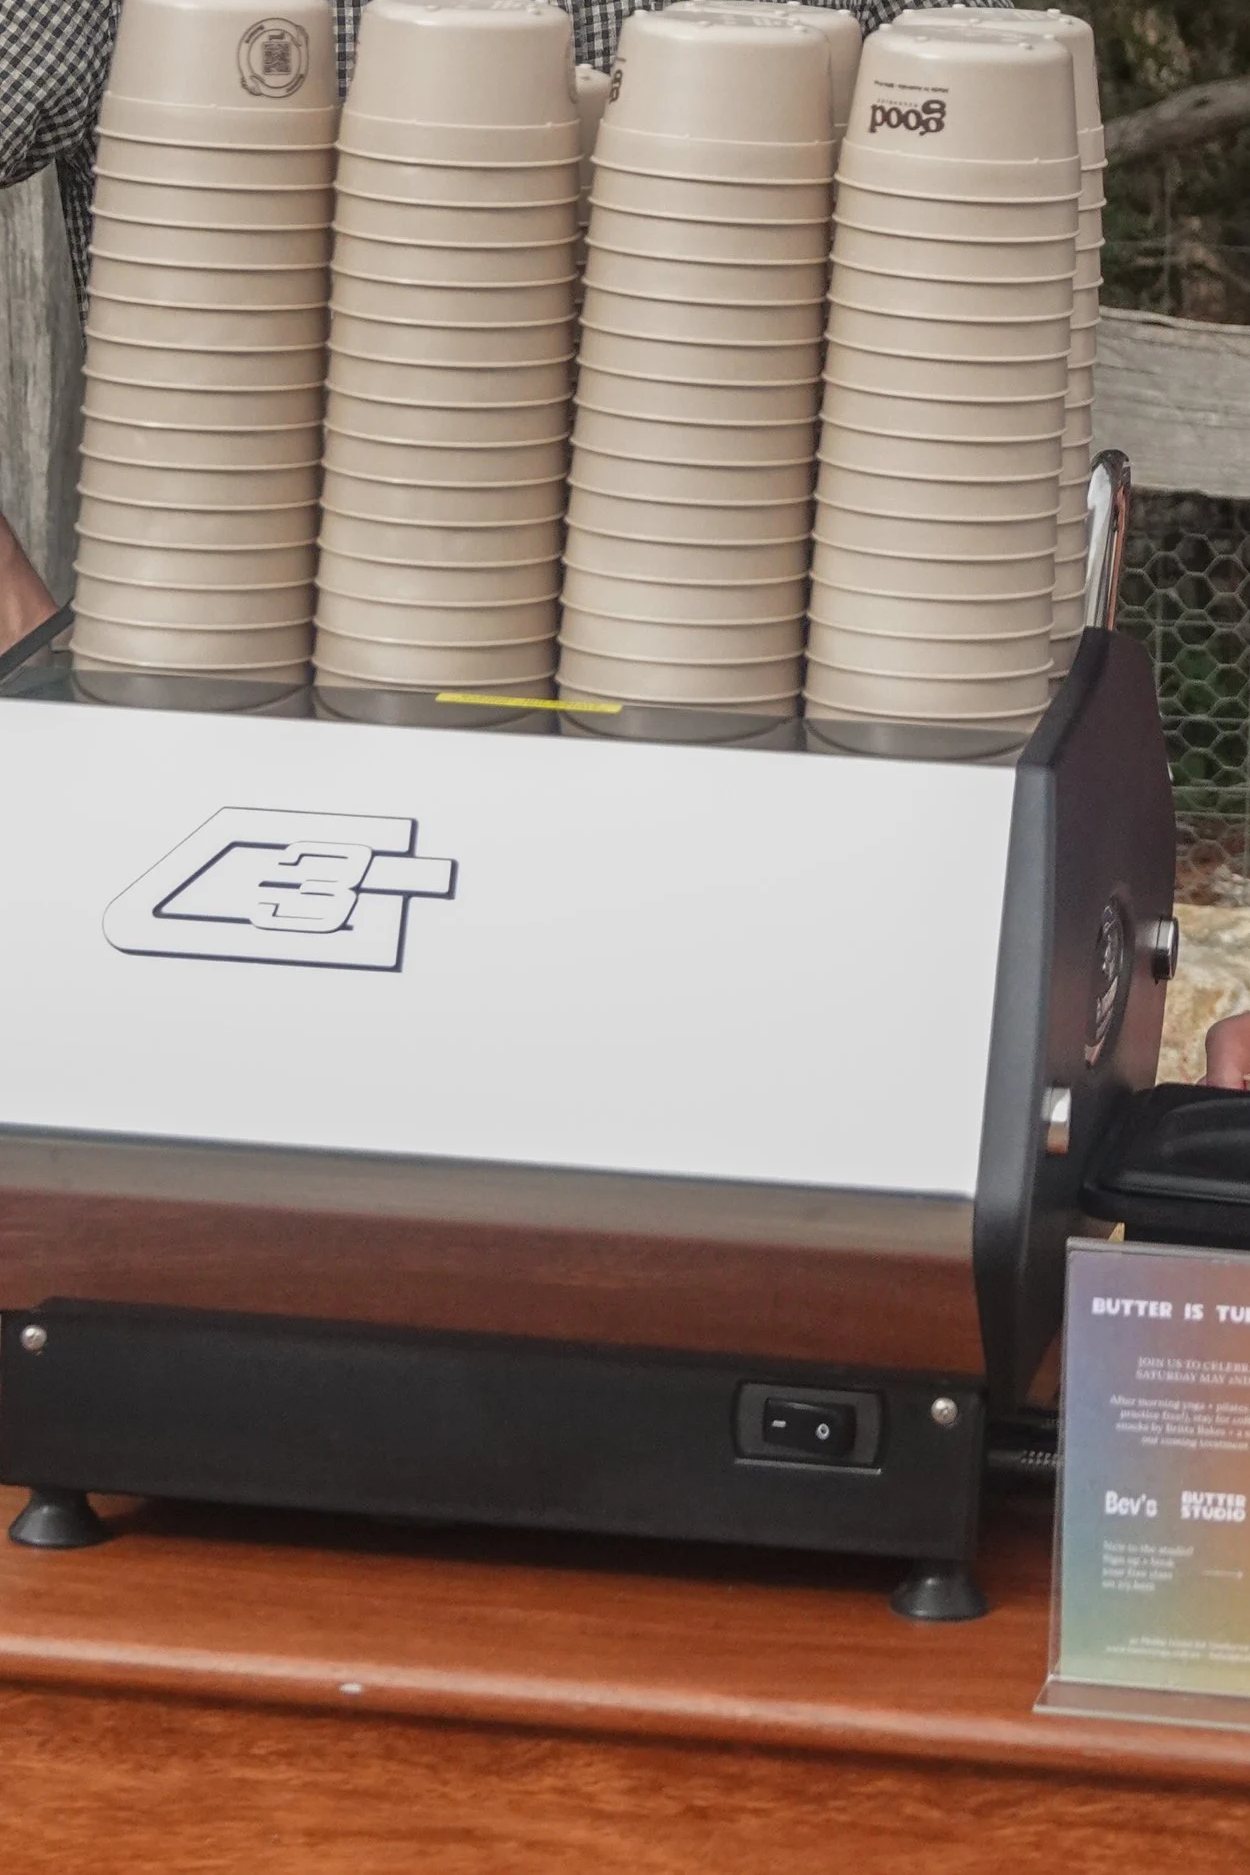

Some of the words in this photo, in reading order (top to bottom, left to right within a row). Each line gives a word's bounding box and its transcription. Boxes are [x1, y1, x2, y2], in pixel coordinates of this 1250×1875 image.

[869, 99, 946, 136] good
[1092, 1297, 1173, 1318] BUTTER
[1184, 1303, 1204, 1321] IS
[1138, 1357, 1164, 1368] JOIN
[1167, 1358, 1182, 1368] US
[1186, 1360, 1200, 1370] TO
[1136, 1369, 1196, 1382] SATURDAY
[1200, 1373, 1224, 1384] MAY
[1110, 1395, 1136, 1406] After
[1139, 1398, 1179, 1410] morning
[1215, 1403, 1248, 1415] pilates
[1120, 1409, 1159, 1421] practice
[1215, 1414, 1229, 1423] for
[1105, 1490, 1158, 1517] Bev's
[1181, 1491, 1246, 1507] BUTTER
[1181, 1504, 1246, 1522] STUDIO
